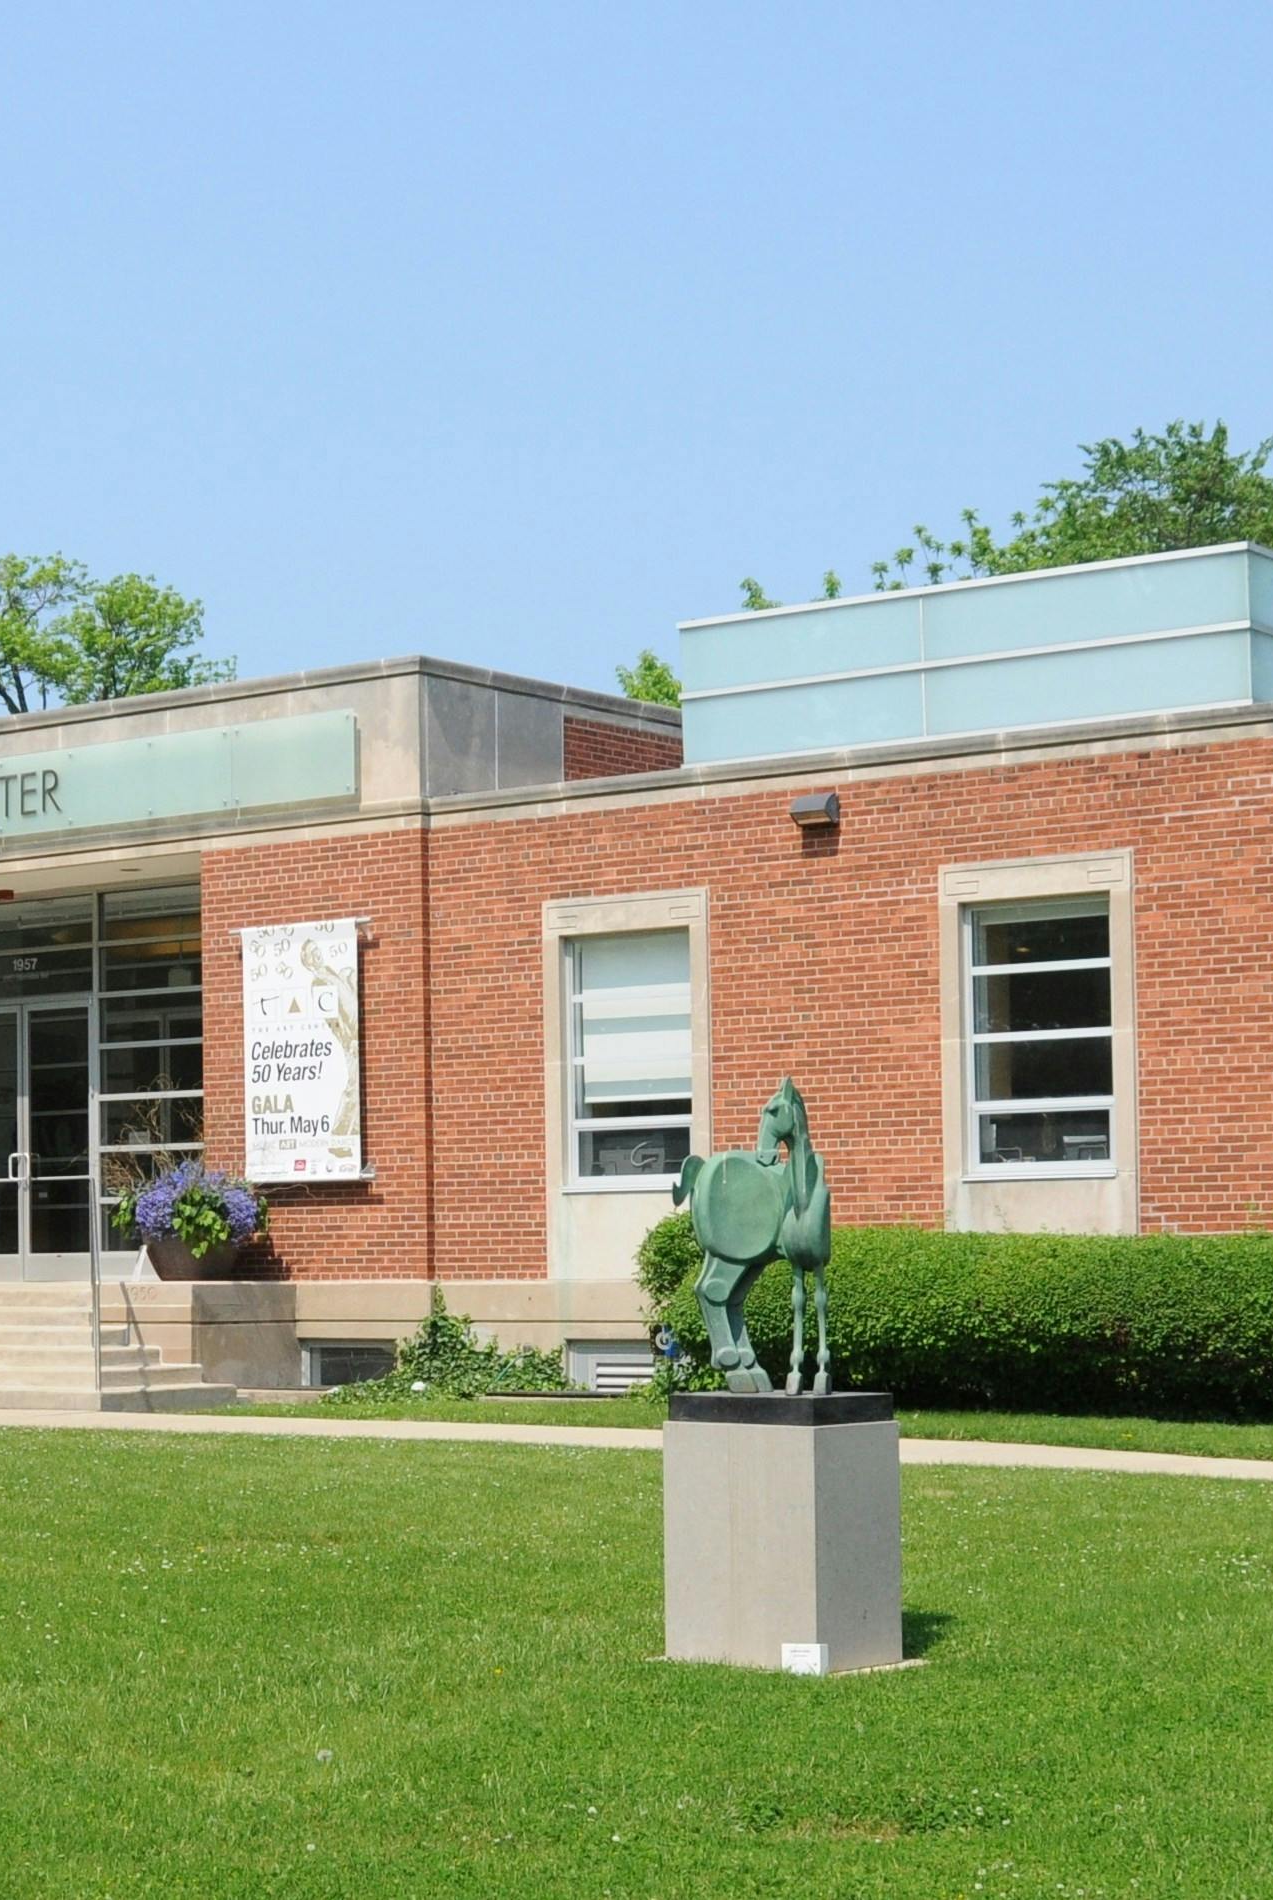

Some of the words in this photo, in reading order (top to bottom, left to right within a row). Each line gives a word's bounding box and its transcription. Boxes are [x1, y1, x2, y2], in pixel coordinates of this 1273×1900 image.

[273, 937, 291, 958] 50
[329, 941, 348, 959] 50
[13, 957, 39, 972] 1957
[250, 963, 268, 982] 50
[251, 1038, 332, 1061] Celebrates
[251, 1063, 271, 1083] 50
[276, 1060, 323, 1082] Years!
[251, 1094, 294, 1115] GALA
[252, 1117, 287, 1136] Thur.
[290, 1116, 320, 1138] May
[320, 1114, 330, 1133] 6
